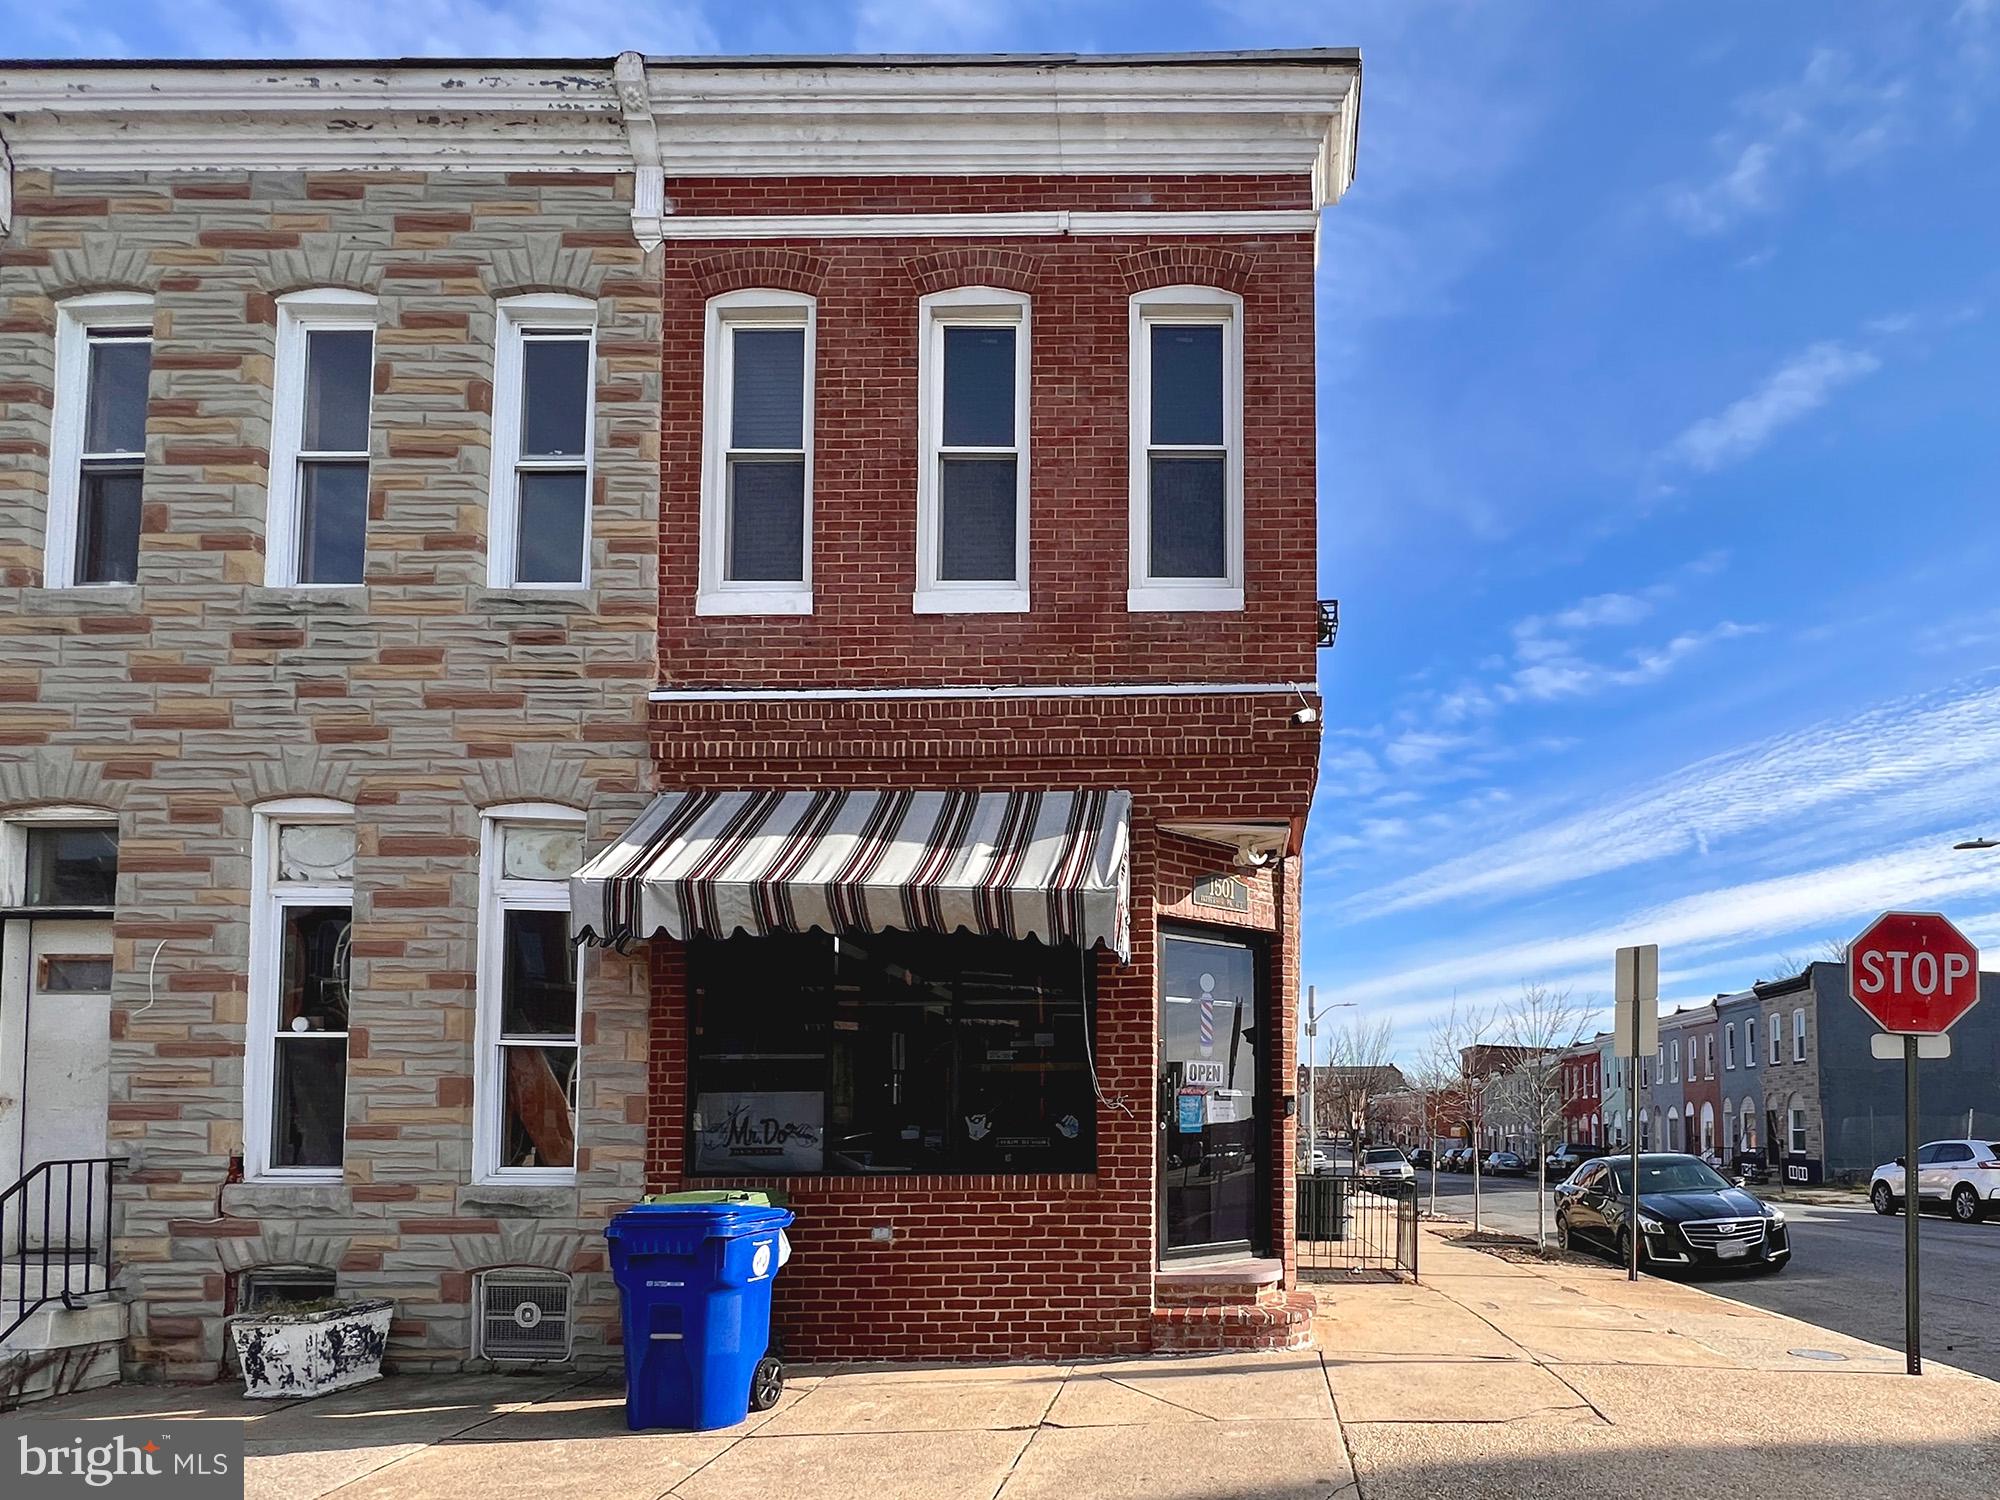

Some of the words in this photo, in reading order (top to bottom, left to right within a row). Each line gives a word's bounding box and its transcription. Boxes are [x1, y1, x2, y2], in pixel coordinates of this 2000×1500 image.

[1209, 878, 1235, 900] 1501
[1859, 949, 1970, 996] STOP
[1189, 1063, 1220, 1082] OPEN
